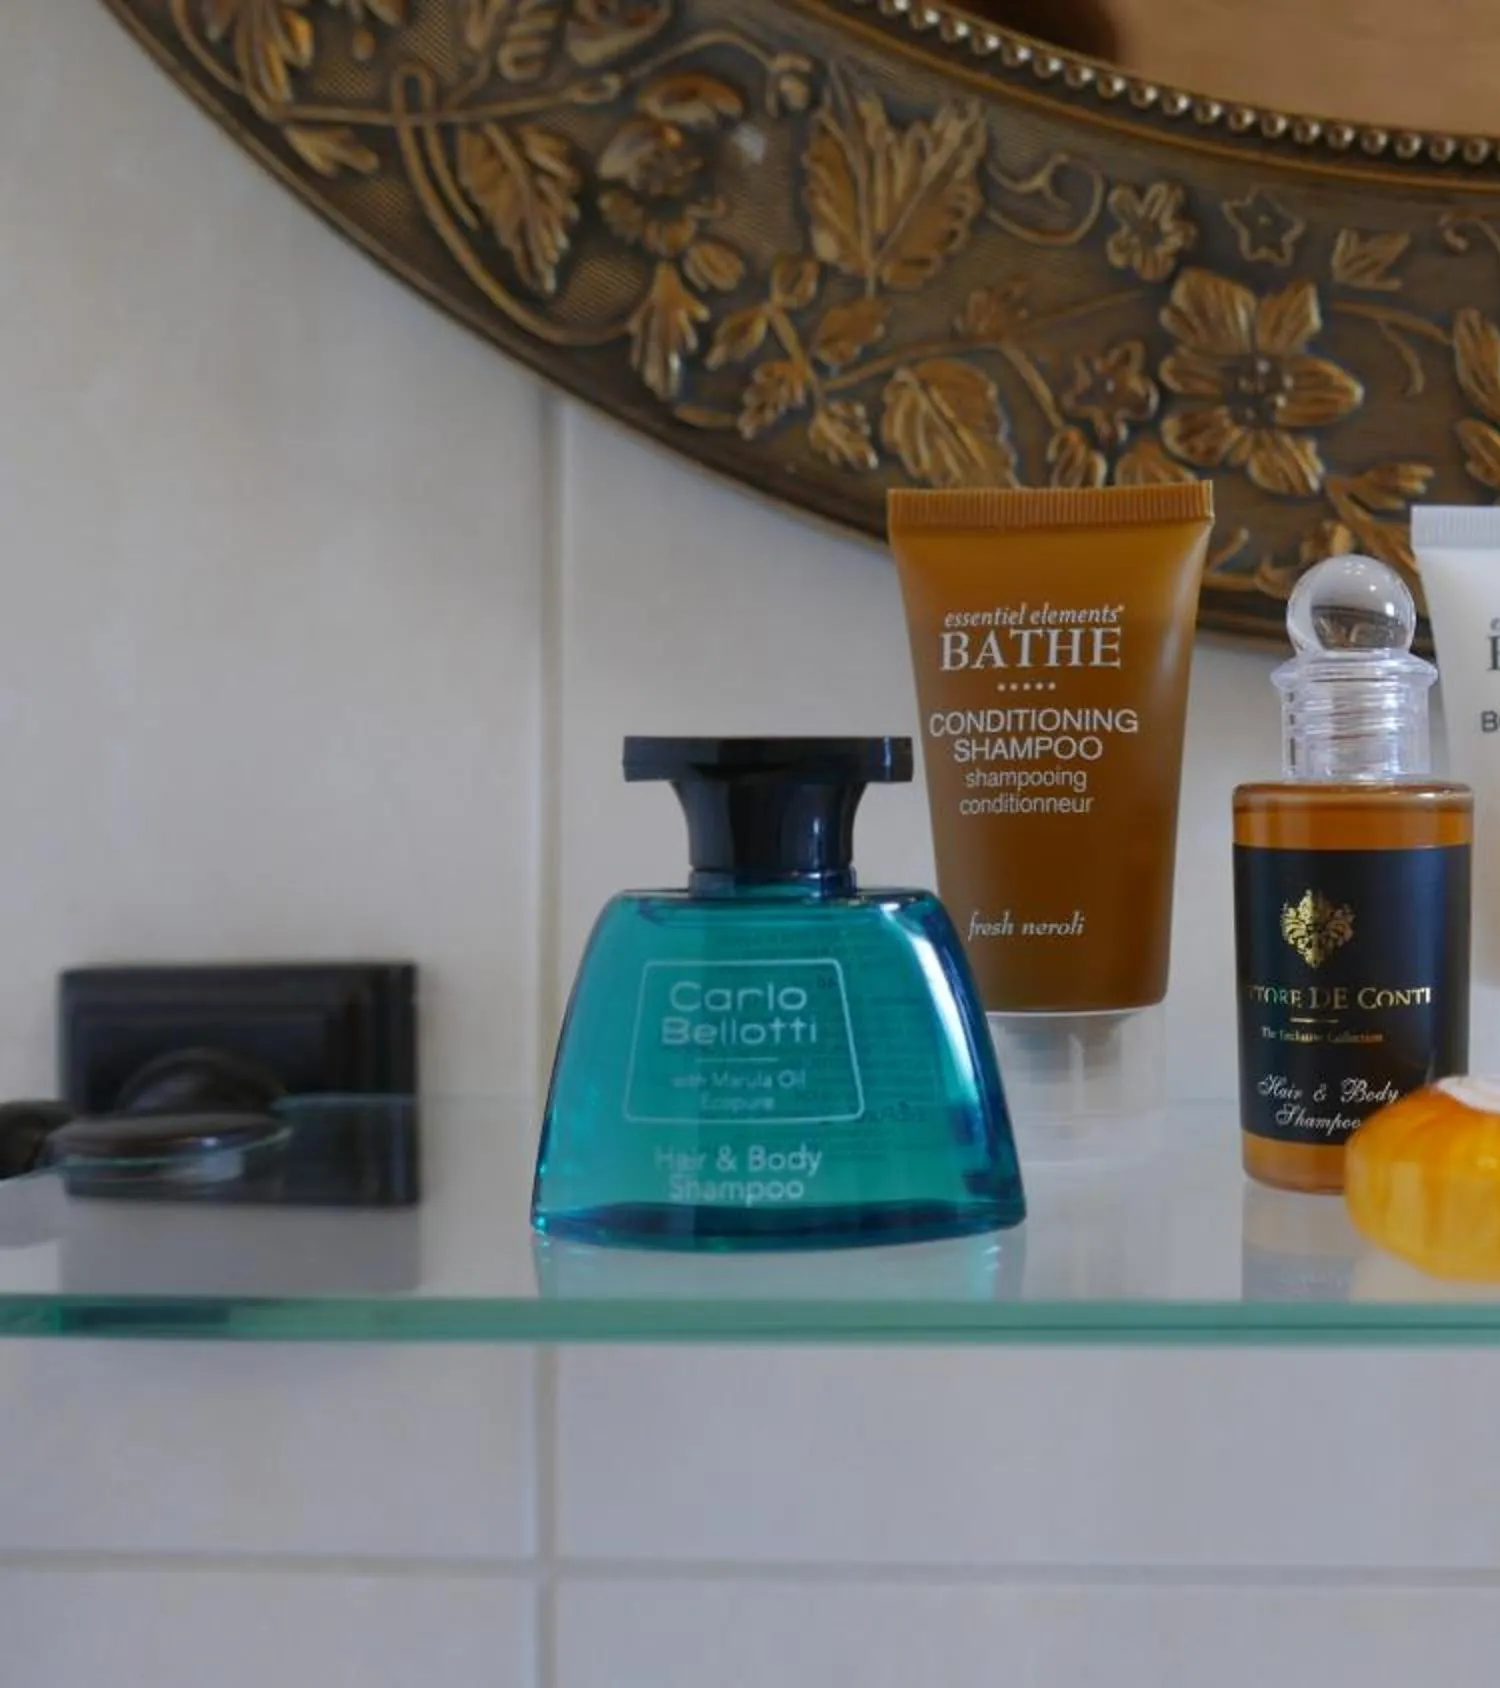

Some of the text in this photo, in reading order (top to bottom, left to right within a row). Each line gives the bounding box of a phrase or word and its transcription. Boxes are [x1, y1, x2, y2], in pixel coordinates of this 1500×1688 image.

[944, 603, 1025, 627] essentiel
[940, 627, 1122, 672] BATHE
[929, 707, 1139, 738] CONDITIONING
[953, 736, 1104, 763] SHAMPOO
[965, 769, 1087, 792] shampooing
[959, 793, 1095, 815] conditionneur
[968, 910, 1086, 941] fresh neroli
[670, 981, 808, 1012] Carlo
[1357, 985, 1433, 1010] CONTI
[660, 1016, 818, 1046] Bellotti
[1257, 1073, 1400, 1104] Hair & Body
[715, 1145, 738, 1172] &
[748, 1141, 824, 1178] Body
[668, 1173, 805, 1208] Shampoo
